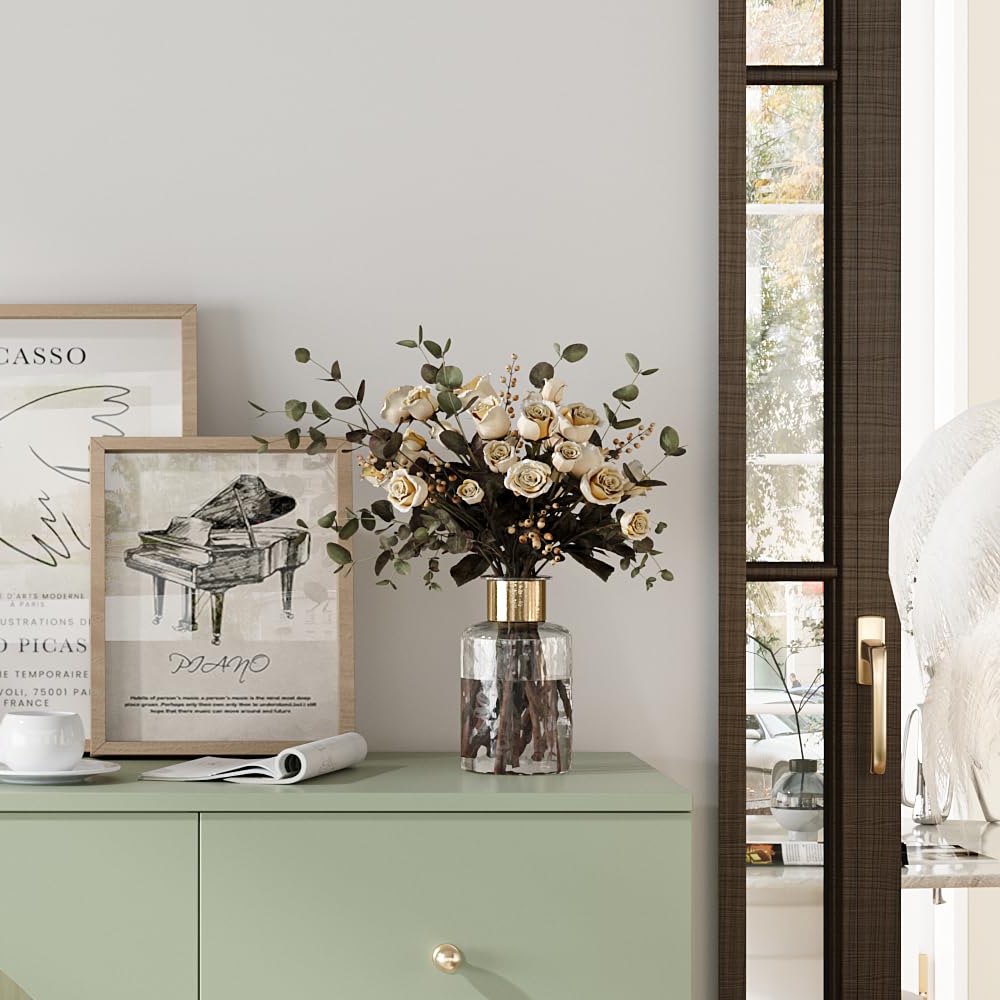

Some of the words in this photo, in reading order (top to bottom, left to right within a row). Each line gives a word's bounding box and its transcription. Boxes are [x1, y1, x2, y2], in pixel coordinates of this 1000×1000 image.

[15, 670, 89, 679] TEMPORAIRE
[33, 688, 68, 697] 75001
[3, 699, 49, 708] FRANCE
